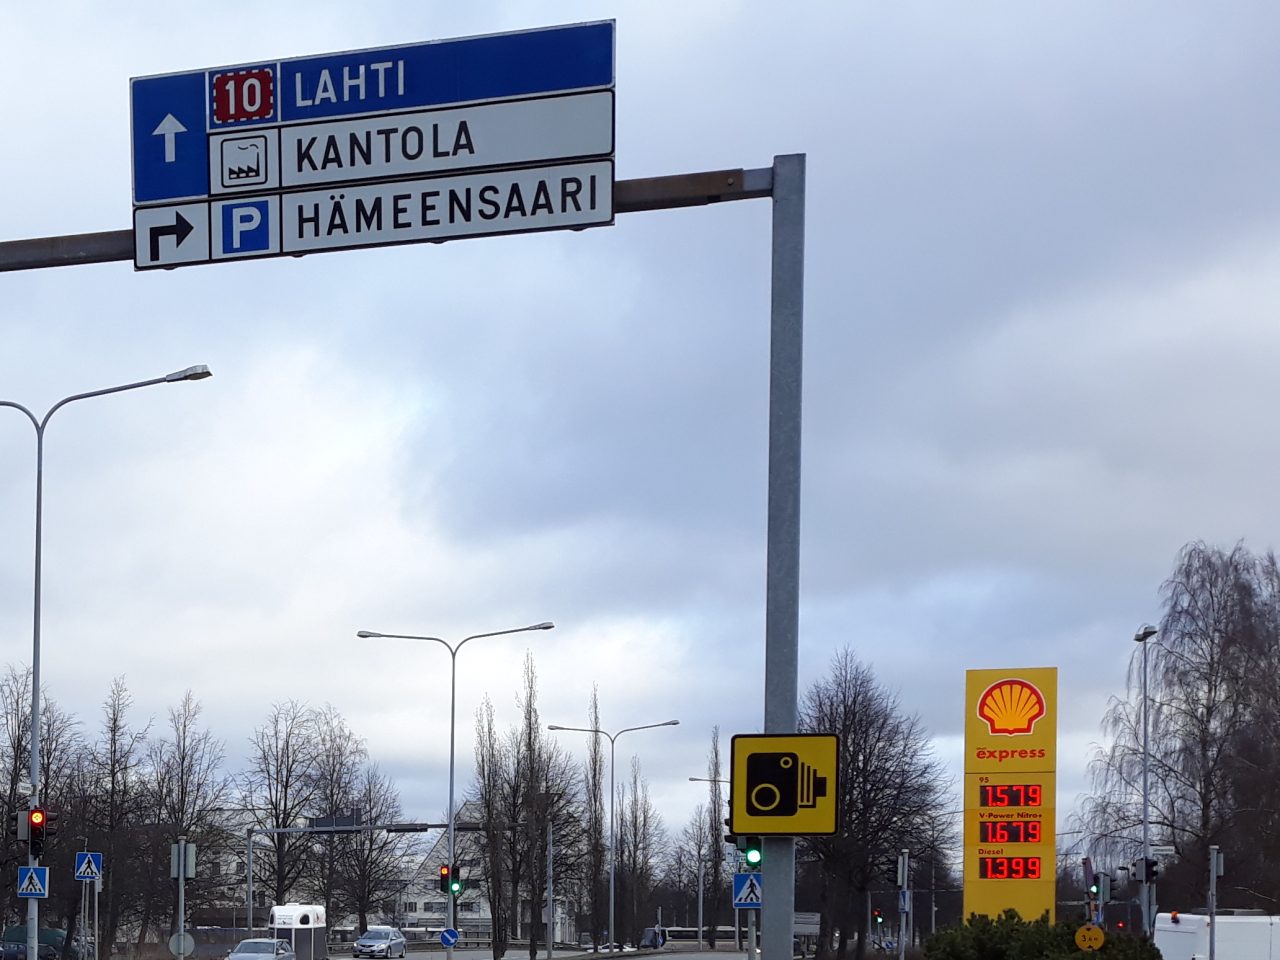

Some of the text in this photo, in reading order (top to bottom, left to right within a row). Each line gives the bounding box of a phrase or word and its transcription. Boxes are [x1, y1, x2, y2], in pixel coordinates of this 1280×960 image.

[225, 60, 405, 115] 10 LAHTI
[296, 120, 475, 173] KANTOLA
[232, 175, 597, 249] P HÄMEENSAARI
[976, 749, 1046, 763] express
[979, 776, 989, 784] 95
[986, 785, 1041, 806] 1.579
[985, 821, 1040, 843] 1.679
[985, 857, 1040, 879] 1.399
